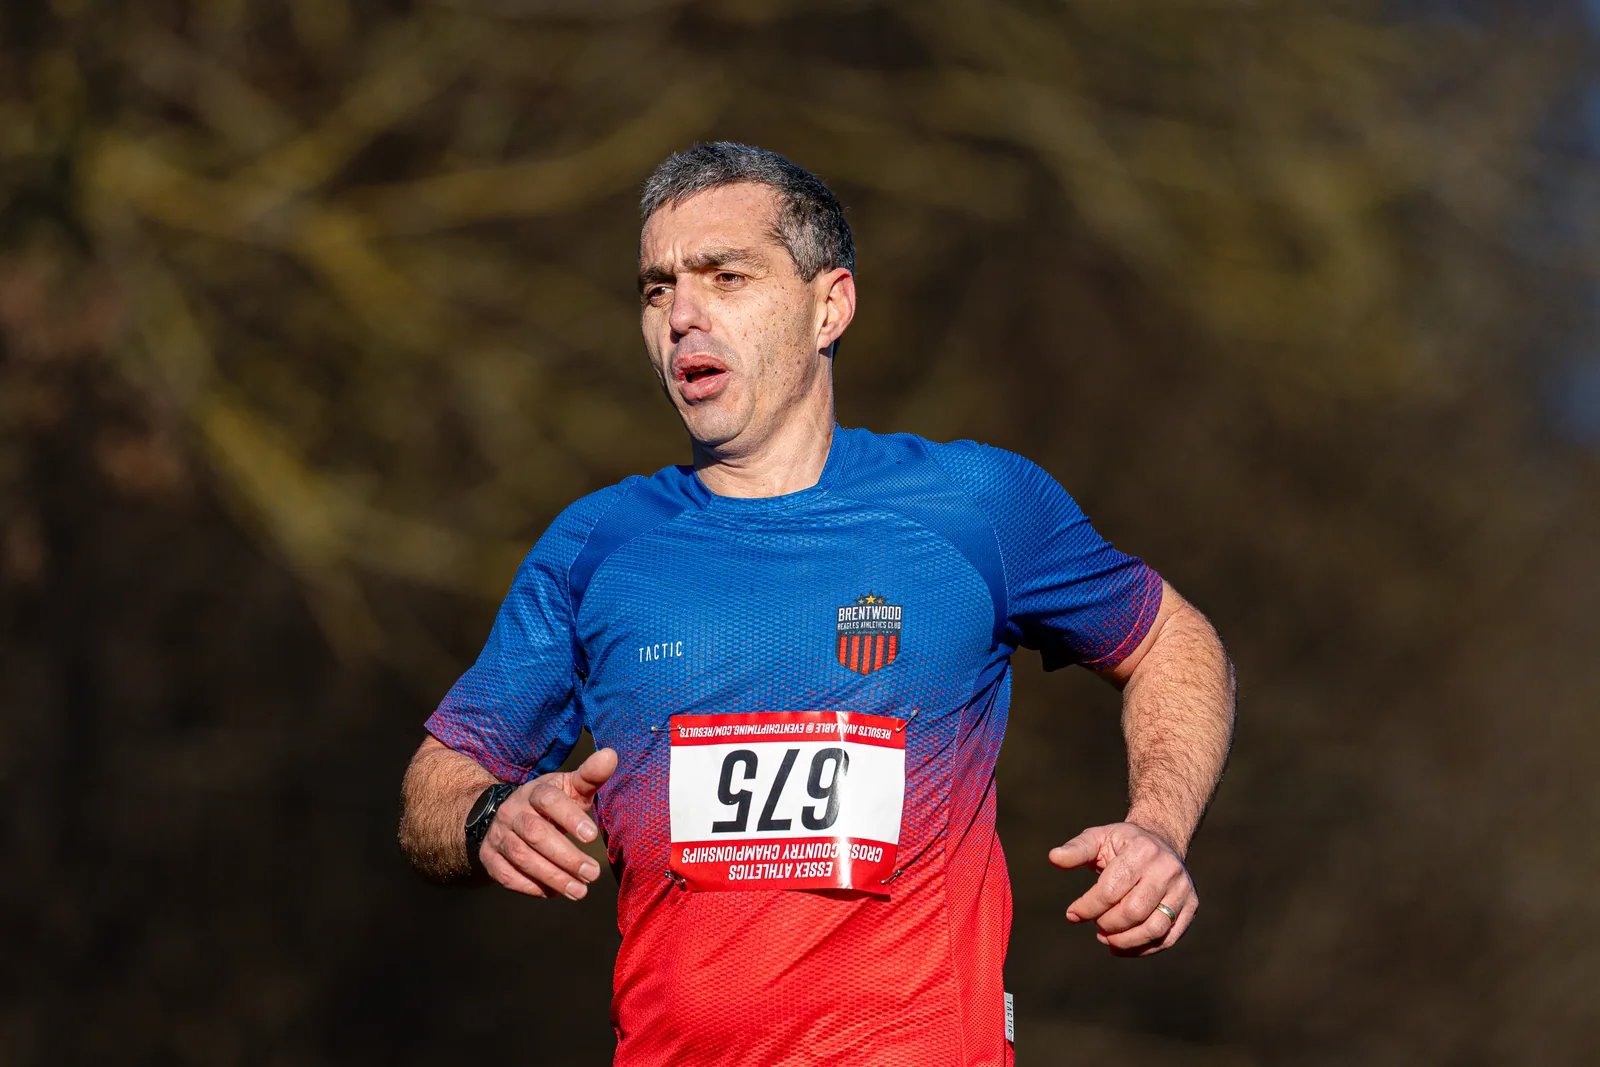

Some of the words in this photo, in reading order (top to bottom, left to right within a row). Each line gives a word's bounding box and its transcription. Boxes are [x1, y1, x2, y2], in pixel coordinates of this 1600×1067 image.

[838, 606, 902, 621] BRENTWOOD
[837, 621, 859, 630] BEAGLES
[860, 621, 887, 629] ATHLETICS
[887, 621, 901, 629] CLUB
[639, 641, 682, 662] TACTIC
[806, 722, 814, 733] @
[815, 723, 858, 734] AVALABLE
[858, 725, 892, 739] RESULTS
[711, 747, 850, 833] 675
[681, 844, 780, 863] CHAMPIONSHIPS
[782, 843, 840, 860] COUNTRY
[728, 862, 793, 880] ATHLETICS
[794, 861, 833, 878] ESSEX
